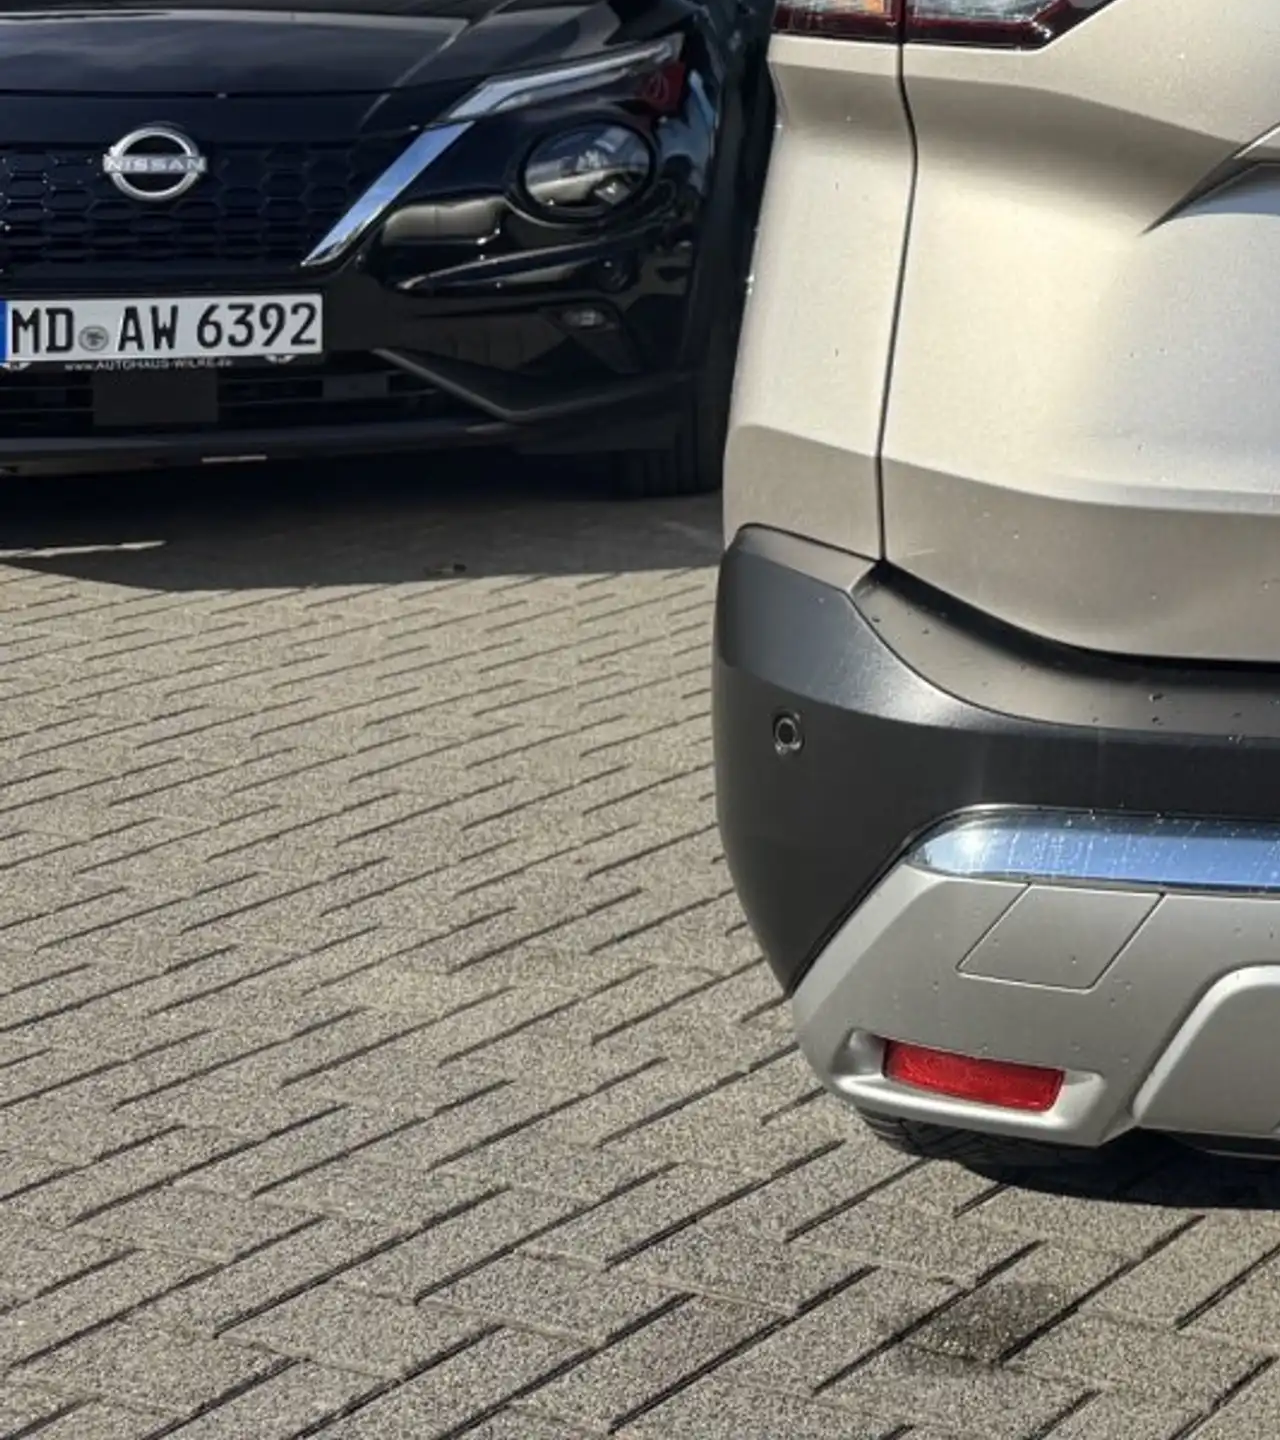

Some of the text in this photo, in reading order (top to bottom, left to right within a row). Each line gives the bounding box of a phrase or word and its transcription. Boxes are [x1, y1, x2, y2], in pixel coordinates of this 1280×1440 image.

[105, 156, 205, 172] NISSAN
[11, 303, 317, 354] MD AW 6392
